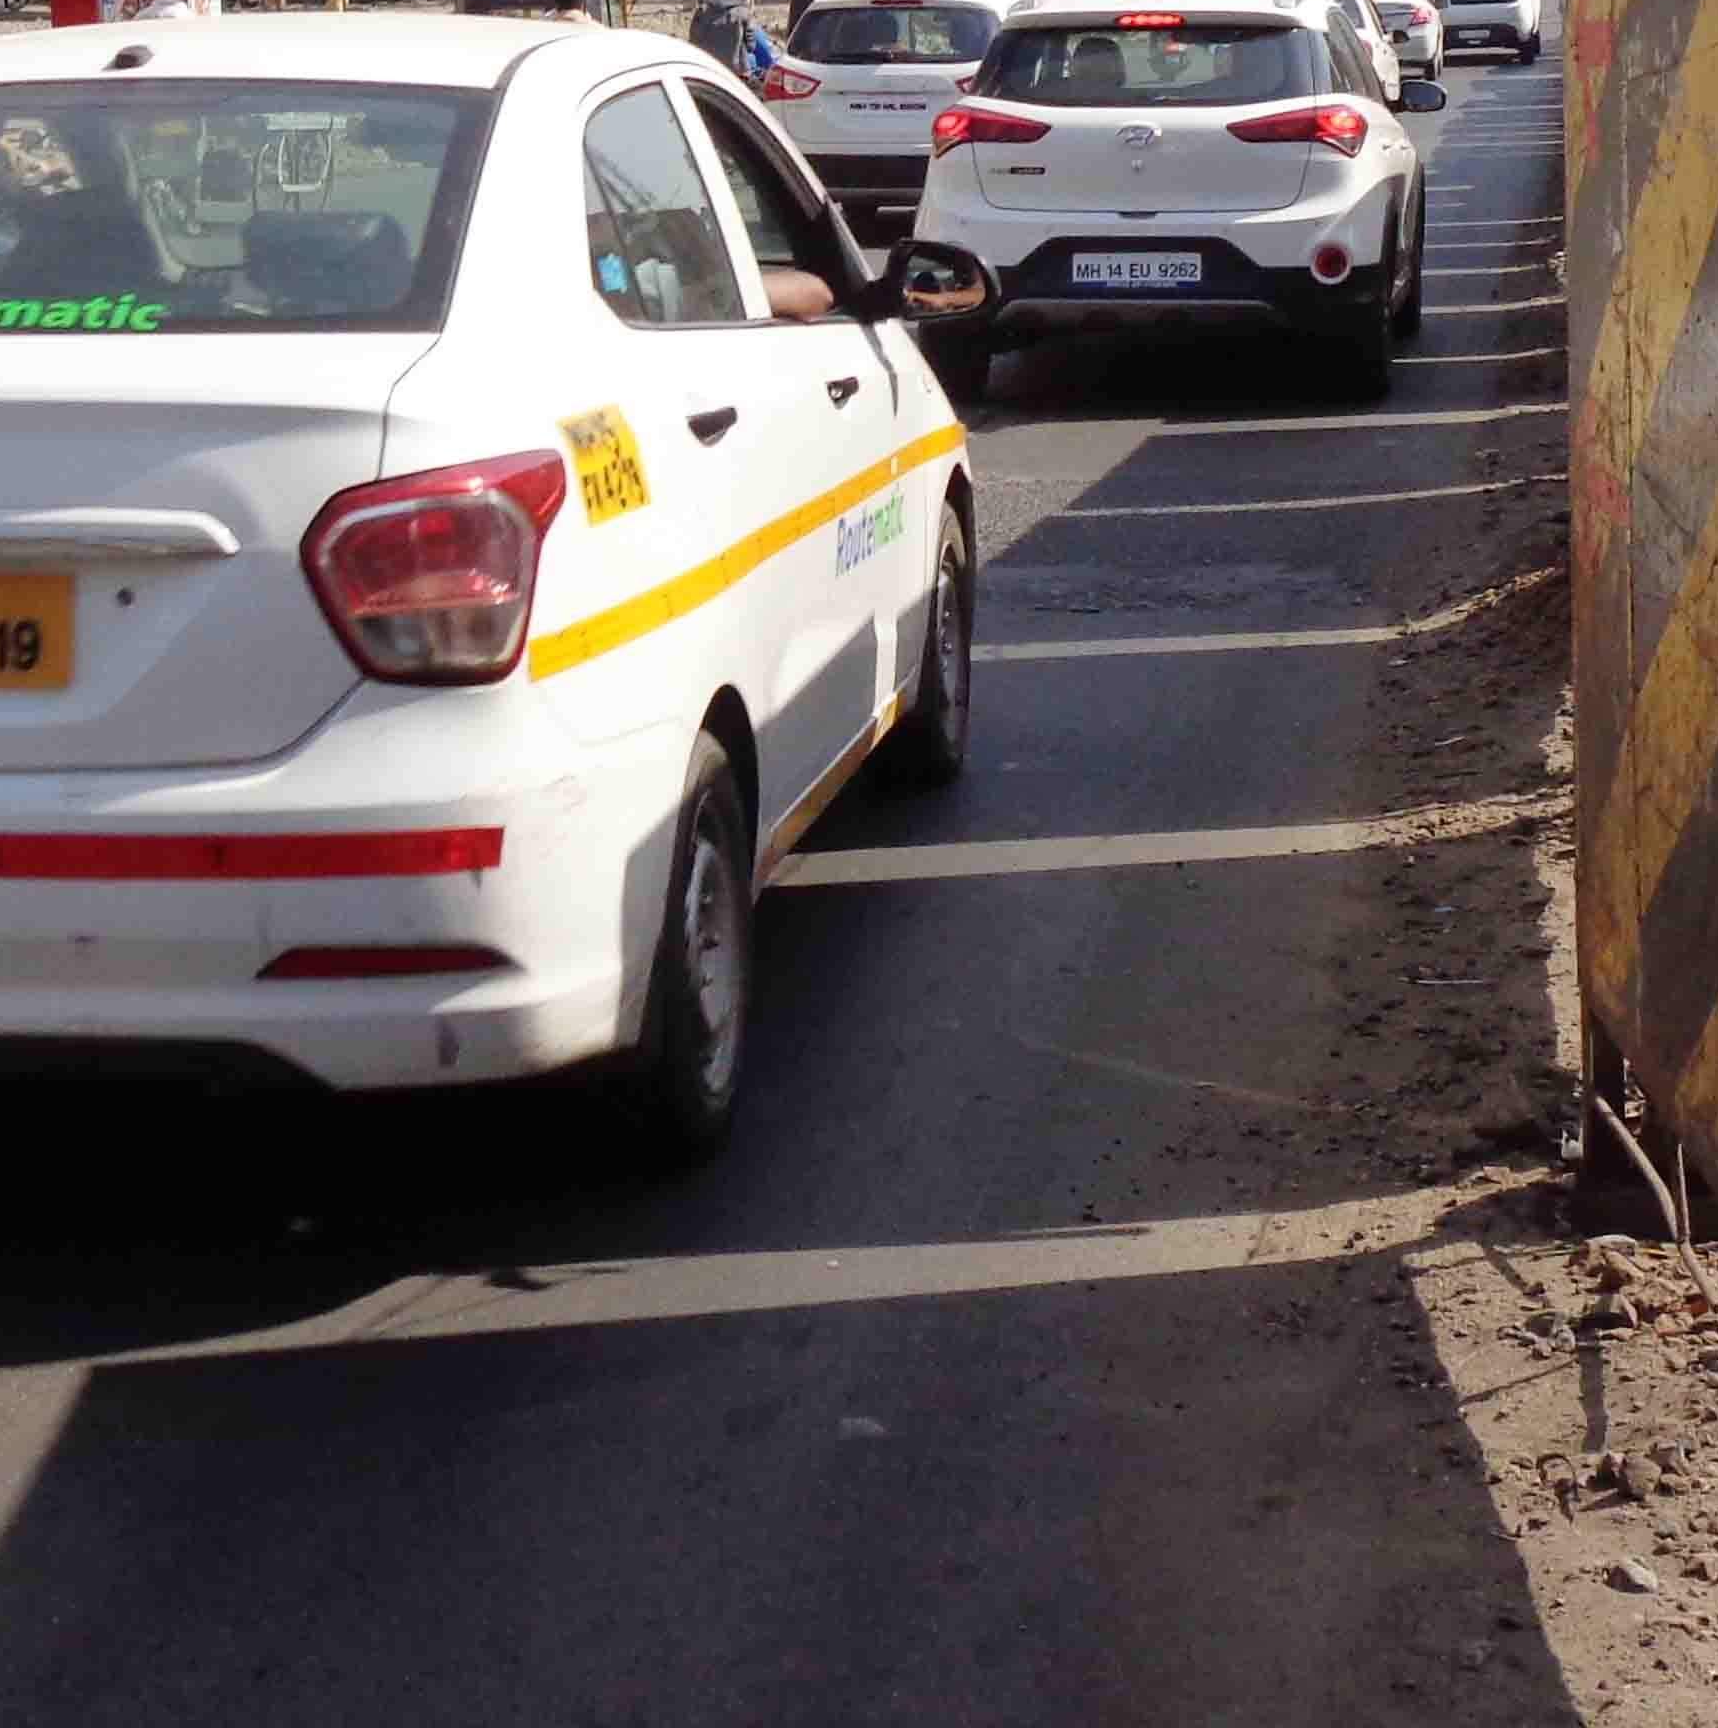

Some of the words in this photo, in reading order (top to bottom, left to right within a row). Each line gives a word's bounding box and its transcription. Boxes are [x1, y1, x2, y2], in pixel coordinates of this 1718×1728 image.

[1076, 263, 1102, 279] MH
[1106, 263, 1123, 279] 14
[1129, 263, 1151, 279] EU
